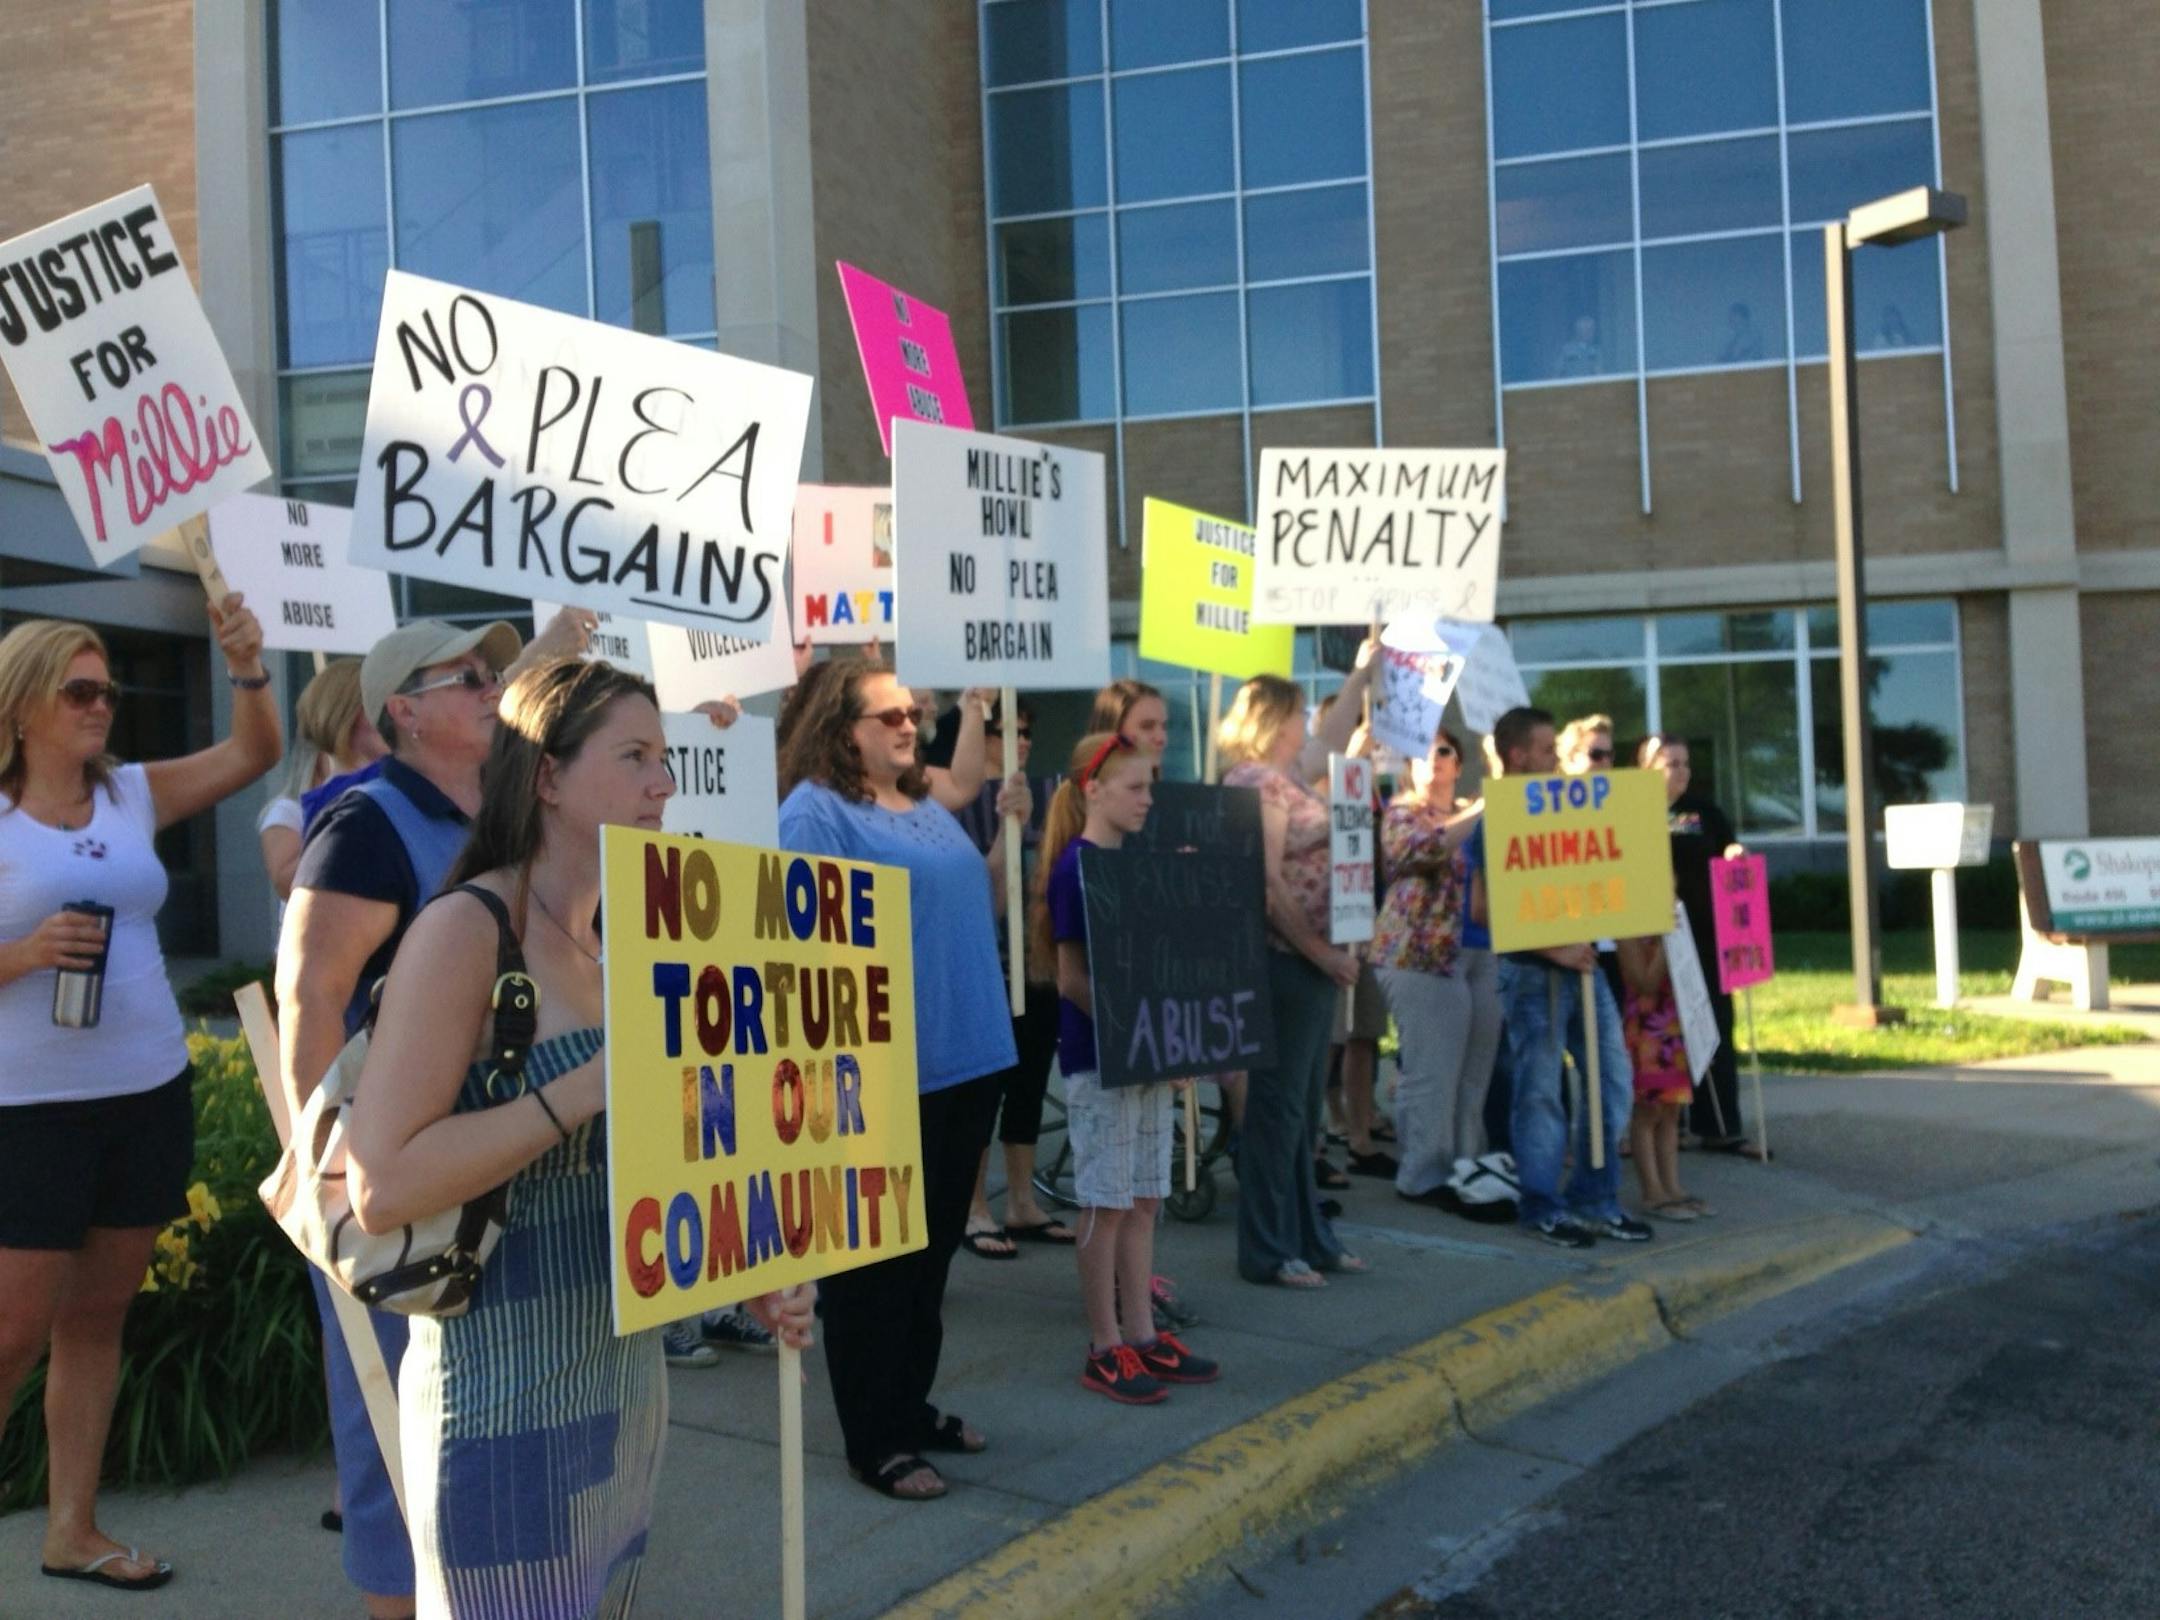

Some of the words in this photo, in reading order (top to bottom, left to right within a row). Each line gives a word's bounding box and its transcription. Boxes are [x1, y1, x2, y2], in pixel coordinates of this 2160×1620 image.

[0, 204, 179, 345] JUSTICE
[70, 325, 157, 402] FOR
[397, 293, 498, 391] NO
[526, 366, 761, 533] PLEA
[48, 382, 252, 541] Millie
[966, 448, 1061, 500] MILLIE'S
[1276, 457, 1498, 503] MAXIMUM
[286, 501, 309, 527] NO
[377, 441, 779, 622] BARGAINS
[982, 496, 1031, 539] HOWL
[1196, 518, 1256, 557] JUSTICE
[1272, 505, 1493, 569] PENALTY
[281, 541, 324, 568] MORE
[950, 552, 976, 594] NO
[1010, 559, 1059, 601] PLEA
[1212, 561, 1238, 589] FOR
[282, 600, 335, 629] ABUSE
[1196, 602, 1249, 635] MILLIE
[965, 620, 1053, 662] BARGAIN
[1525, 776, 1610, 816] STOP
[1504, 826, 1623, 872] ANIMAL
[643, 842, 721, 942] NO
[754, 852, 877, 948] MORE
[652, 961, 892, 1058] TORTURE
[1126, 989, 1261, 1071] ABUSE
[682, 1063, 737, 1162] IN
[771, 1054, 867, 1146] OUR
[624, 1164, 914, 1300] COMMUNITY
